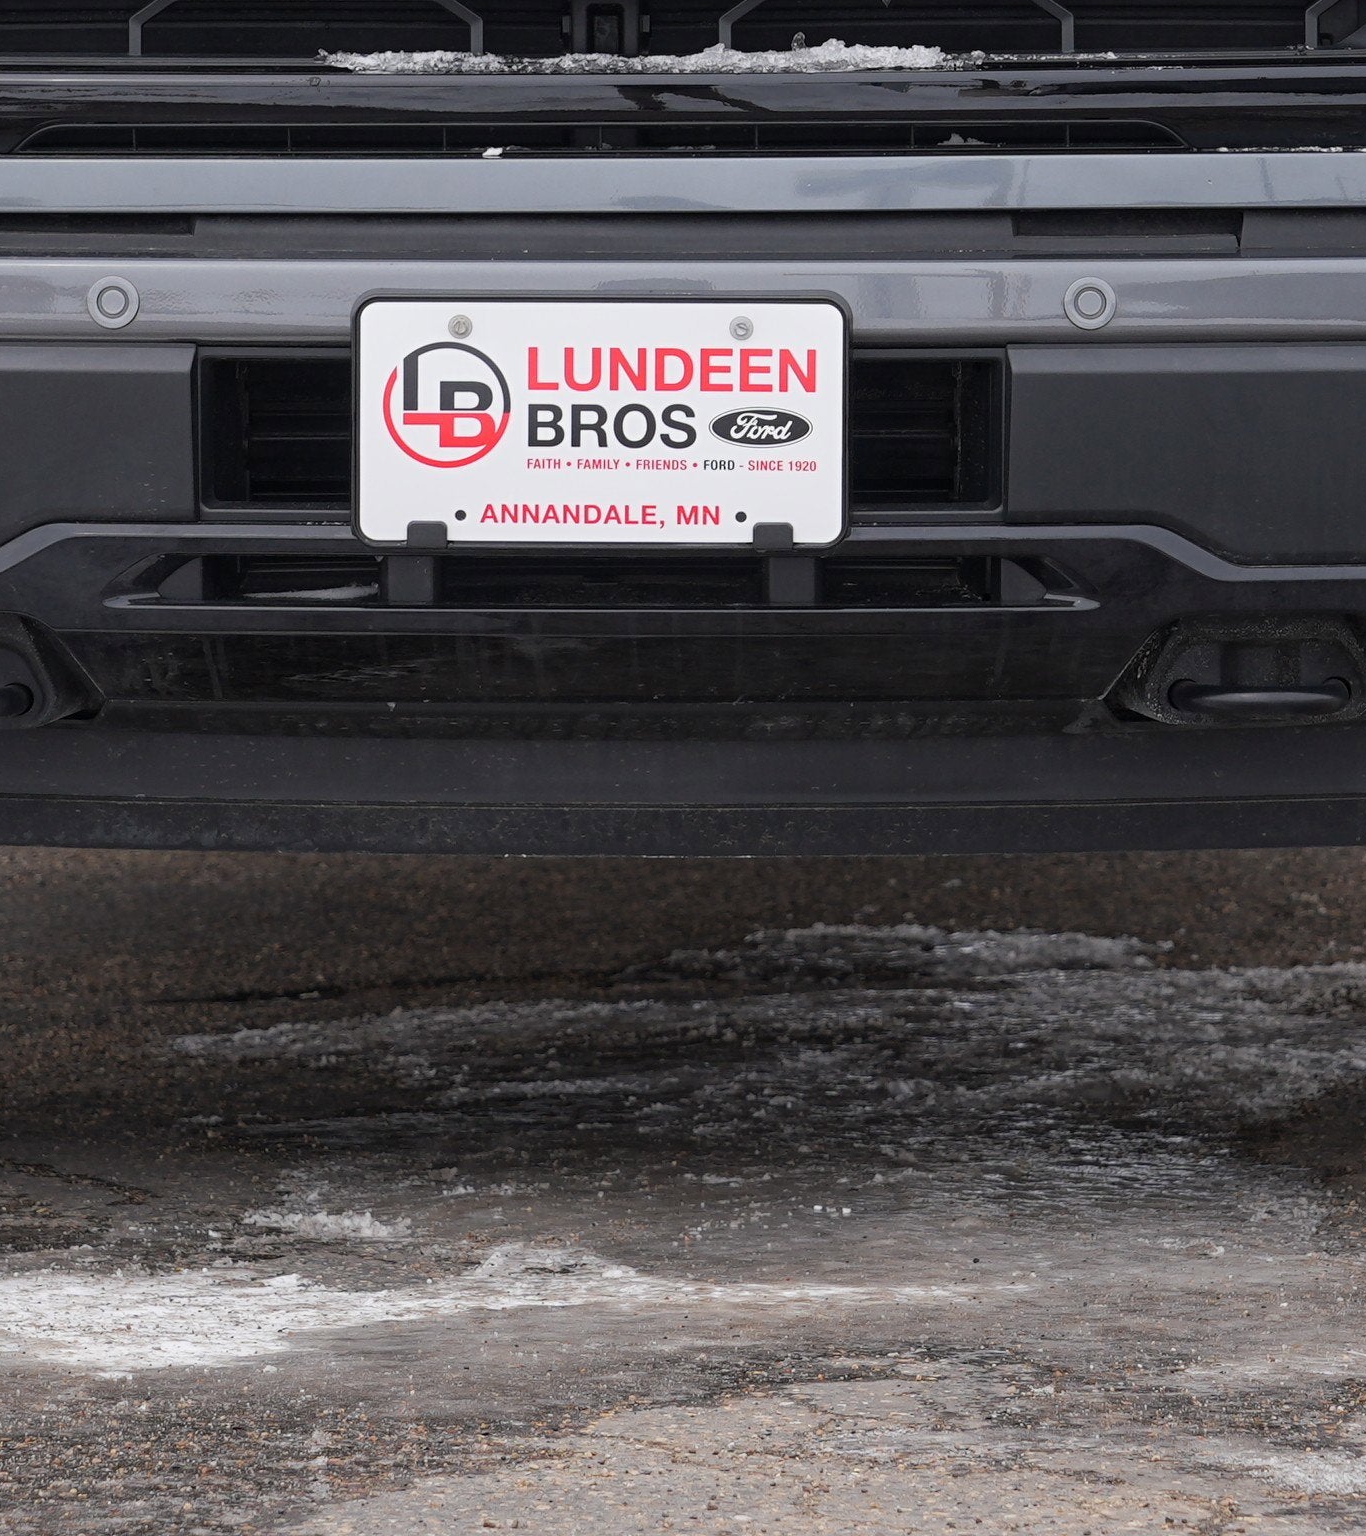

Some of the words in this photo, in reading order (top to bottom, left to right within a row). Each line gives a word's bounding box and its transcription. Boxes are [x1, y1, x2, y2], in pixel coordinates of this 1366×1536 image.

[527, 346, 817, 393] LUNDEEN
[527, 403, 697, 449] BROS
[729, 411, 794, 441] Ford
[526, 458, 561, 470] FAITH
[577, 458, 620, 470] FAMILY
[635, 459, 688, 471] FRIENDS
[703, 459, 736, 471] FORD
[747, 460, 784, 472] SINCE
[788, 460, 817, 472] 1920
[479, 503, 665, 529] ANNANDALE,
[676, 505, 721, 526] MN
